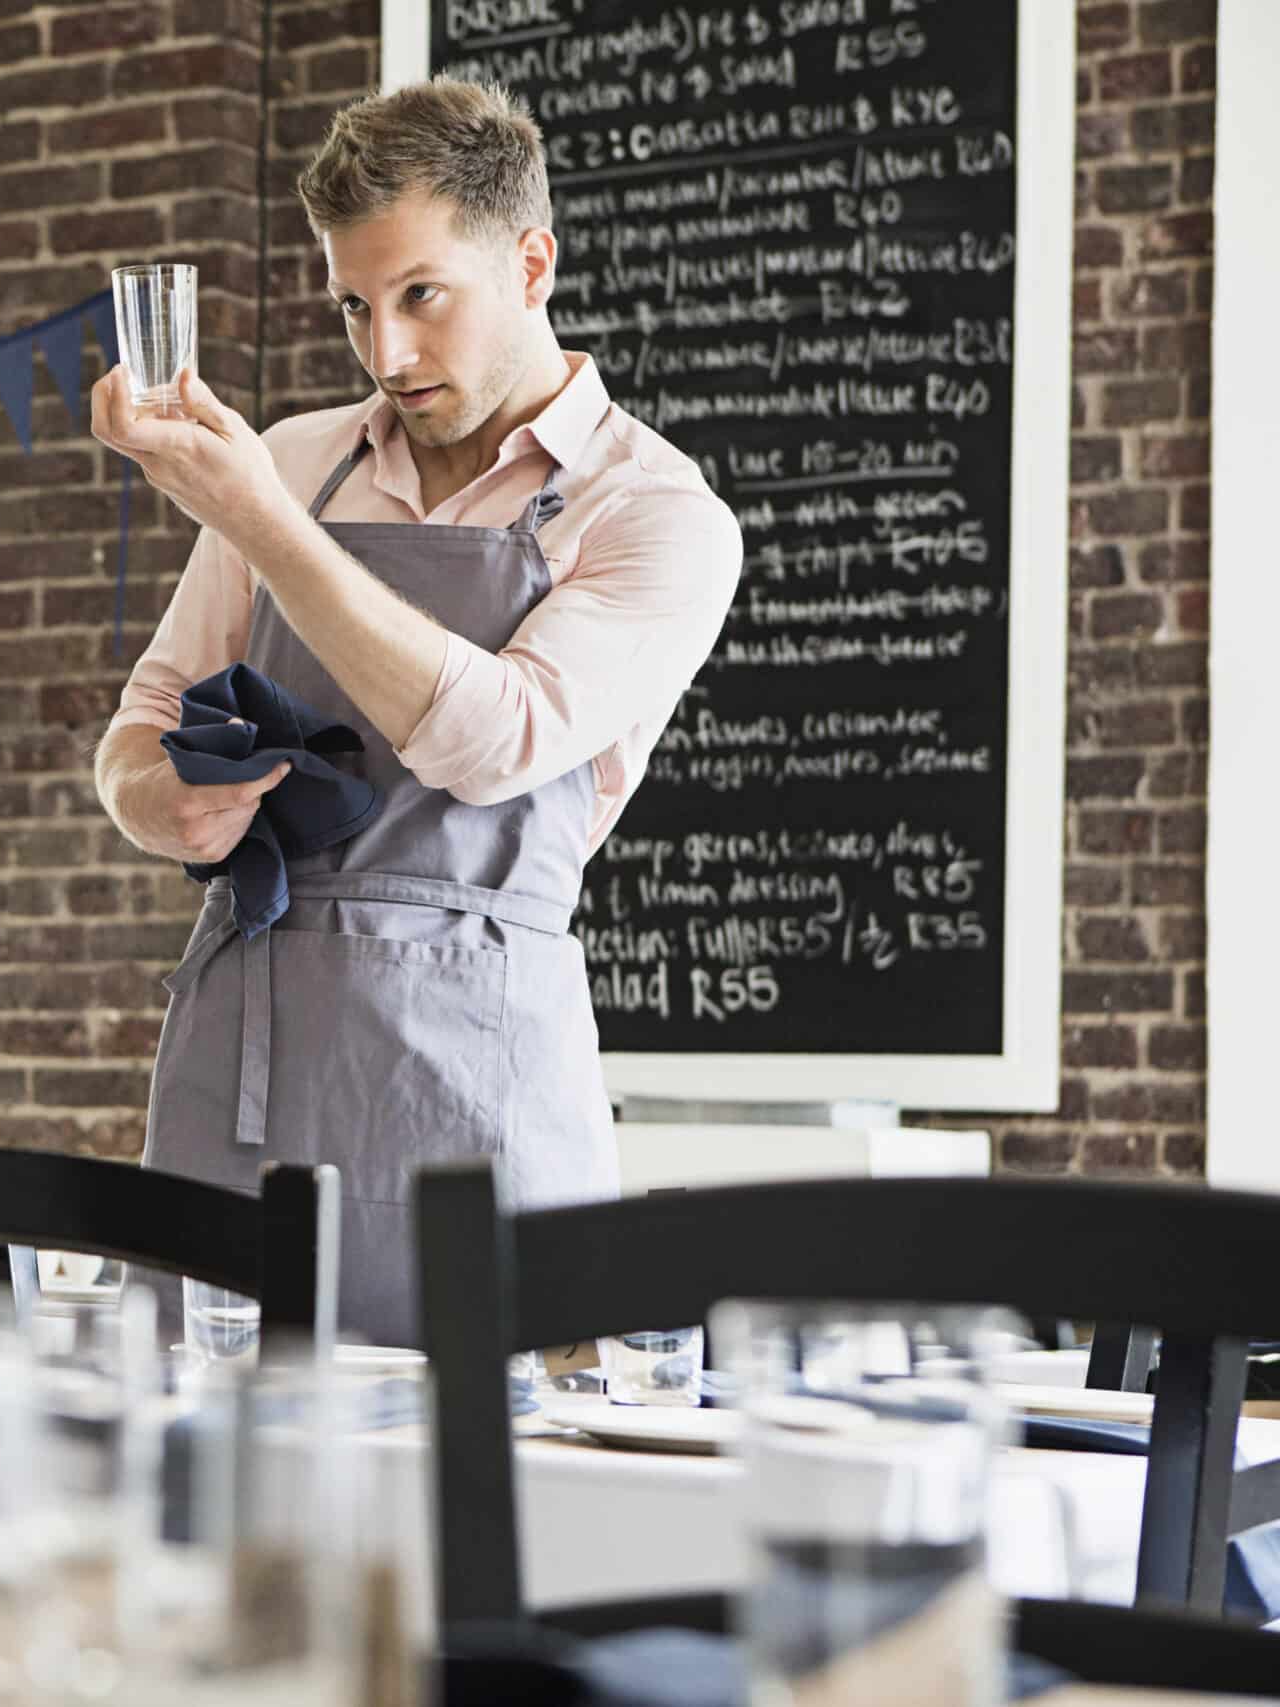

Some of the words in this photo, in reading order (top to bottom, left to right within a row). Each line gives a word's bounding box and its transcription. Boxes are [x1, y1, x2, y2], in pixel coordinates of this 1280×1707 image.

[835, 18, 926, 74] R55
[833, 188, 902, 230] R40
[586, 960, 671, 1019] alad
[689, 964, 780, 1020] R55
